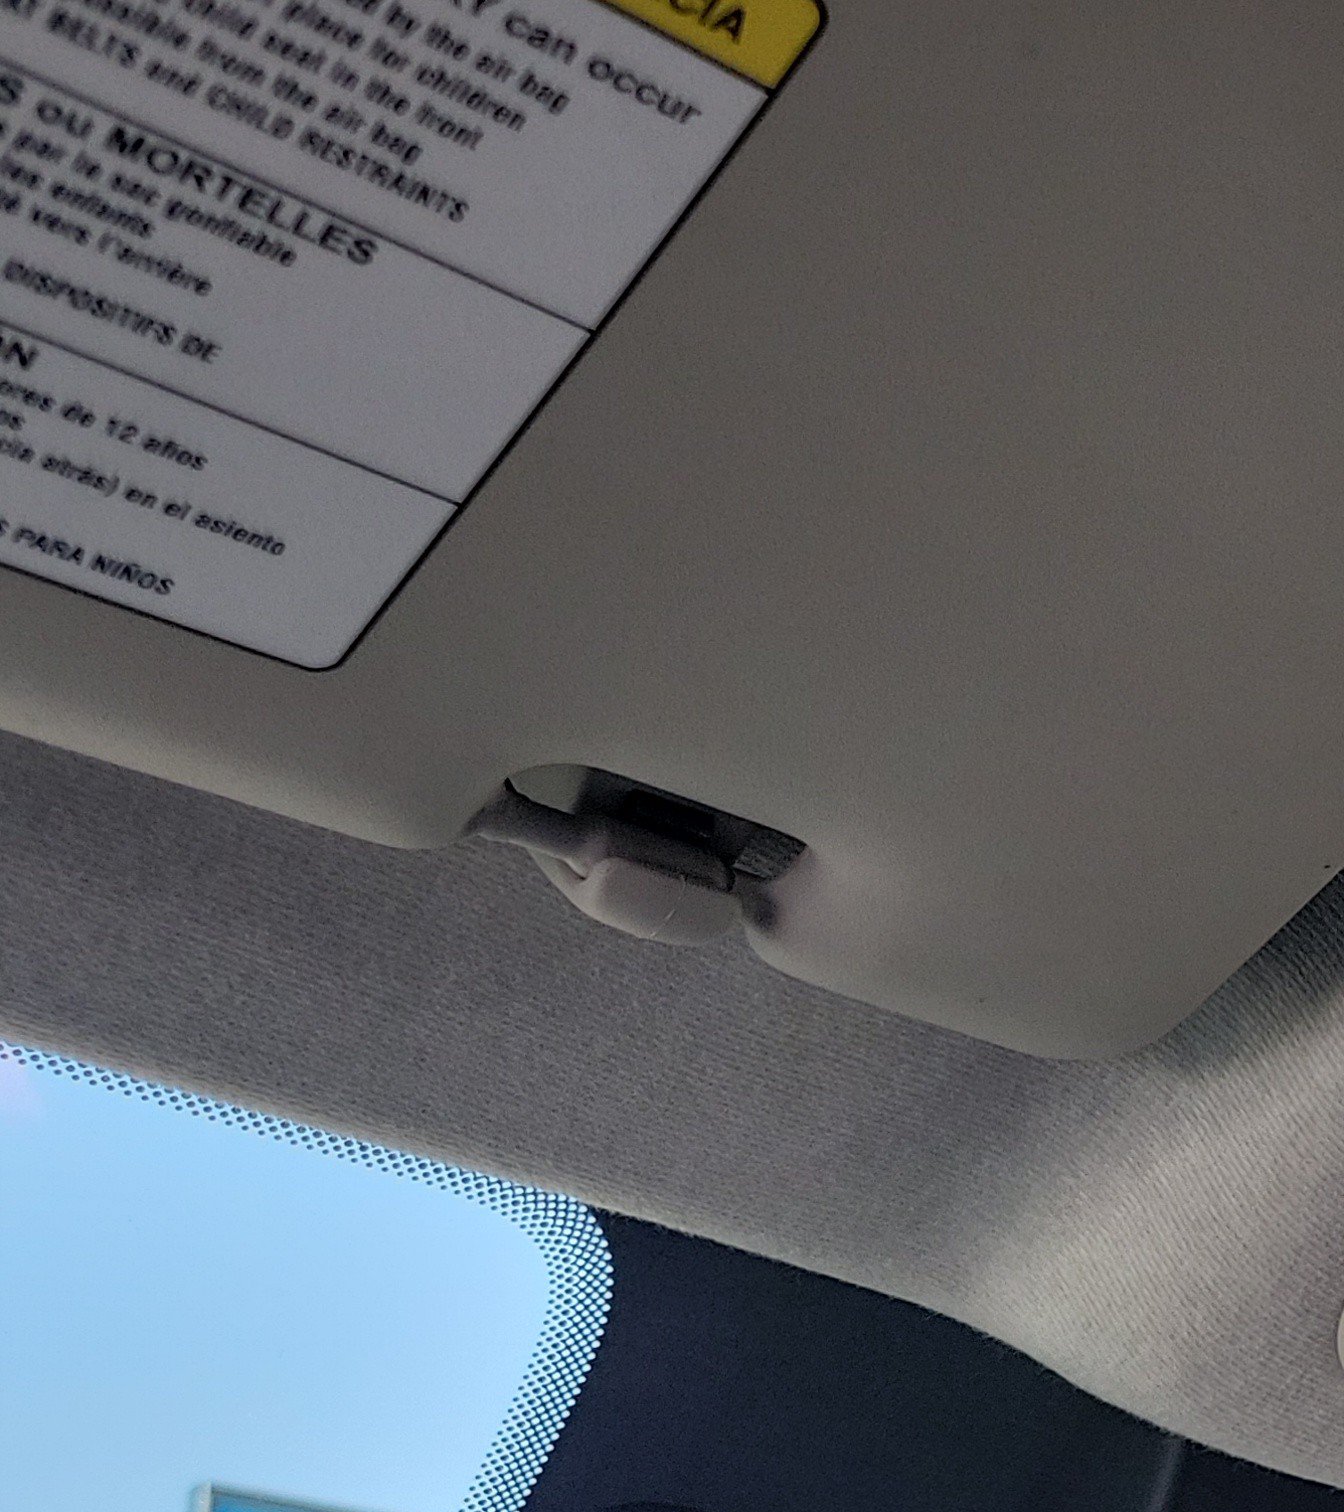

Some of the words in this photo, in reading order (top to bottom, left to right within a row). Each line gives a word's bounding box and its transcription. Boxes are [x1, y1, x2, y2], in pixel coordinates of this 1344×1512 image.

[414, 62, 527, 132] children
[424, 20, 470, 60] the
[474, 51, 515, 82] air
[518, 70, 571, 116] bag
[504, 11, 578, 65] can
[586, 56, 702, 125] occur
[271, 71, 320, 112] the
[368, 118, 423, 166] bag
[363, 74, 411, 116] the
[414, 100, 485, 150] front
[36, 99, 94, 139] ou
[105, 123, 379, 266] MORTELLES
[204, 81, 295, 141] CHILD
[298, 123, 471, 223] RESTRAINTS
[180, 332, 223, 364] DE
[60, 400, 97, 429] de
[104, 415, 141, 444] 12
[143, 433, 209, 471] años
[123, 483, 160, 510] en
[163, 500, 194, 522] el
[194, 509, 287, 557] asiento
[12, 525, 86, 566] PARA
[91, 551, 174, 596] NIÑOS
